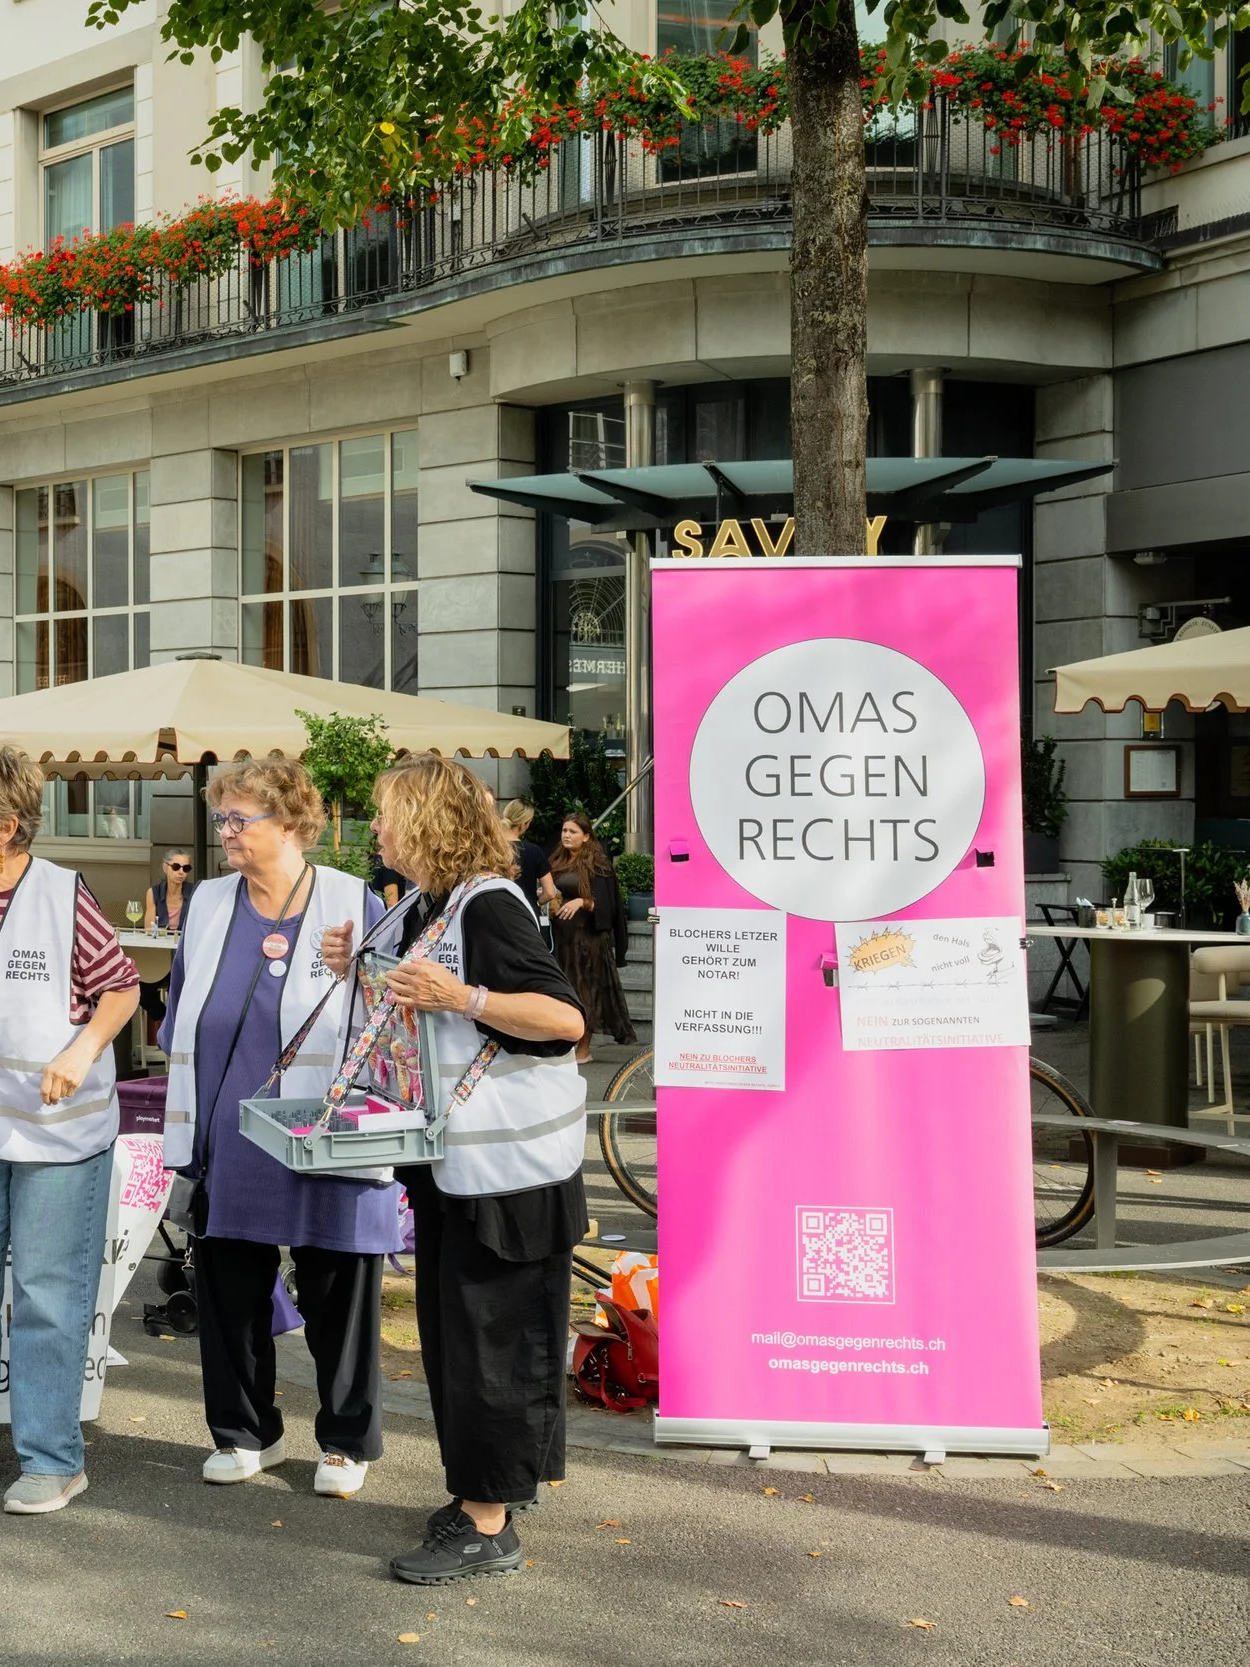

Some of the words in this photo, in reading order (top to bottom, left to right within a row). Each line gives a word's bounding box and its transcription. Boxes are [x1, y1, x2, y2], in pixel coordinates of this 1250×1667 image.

[672, 515, 887, 558] SAVY
[753, 691, 918, 734] OMAS
[745, 754, 928, 797] GEGEN
[738, 818, 940, 862] RECHTS
[669, 929, 731, 940] BLOCHERS
[735, 931, 778, 941] LETZER
[933, 933, 949, 942] den
[951, 936, 970, 948] Hals
[706, 943, 740, 953] WILLE
[12, 949, 46, 960] OMAS
[438, 954, 459, 964] EGE
[854, 944, 906, 971] KRIEGEN
[7, 960, 46, 971] GEGEN
[682, 955, 729, 966] GEHÖRT
[732, 957, 757, 967] ZUM
[931, 960, 953, 972] nicht
[954, 956, 970, 966] voll
[5, 971, 50, 982] RECHTS
[697, 970, 740, 980] NOTAR!
[684, 1009, 718, 1019] NICHT
[721, 1011, 732, 1020] IN
[735, 1011, 754, 1021] DIE
[856, 1015, 888, 1027] NEIN
[892, 1018, 909, 1026] ZUR
[912, 1016, 980, 1025] SOGENANNTEN
[675, 1022, 762, 1035] VERFASSUNG!!!
[858, 1032, 1005, 1048] NEUTRALITÄTSINITIATIVE
[679, 1053, 698, 1061] NEIN
[712, 1054, 757, 1063] BLOCHERS
[751, 1331, 946, 1351] mail@omasgegenrechts.ch
[768, 1357, 929, 1375] omasgegenrechts.ch
